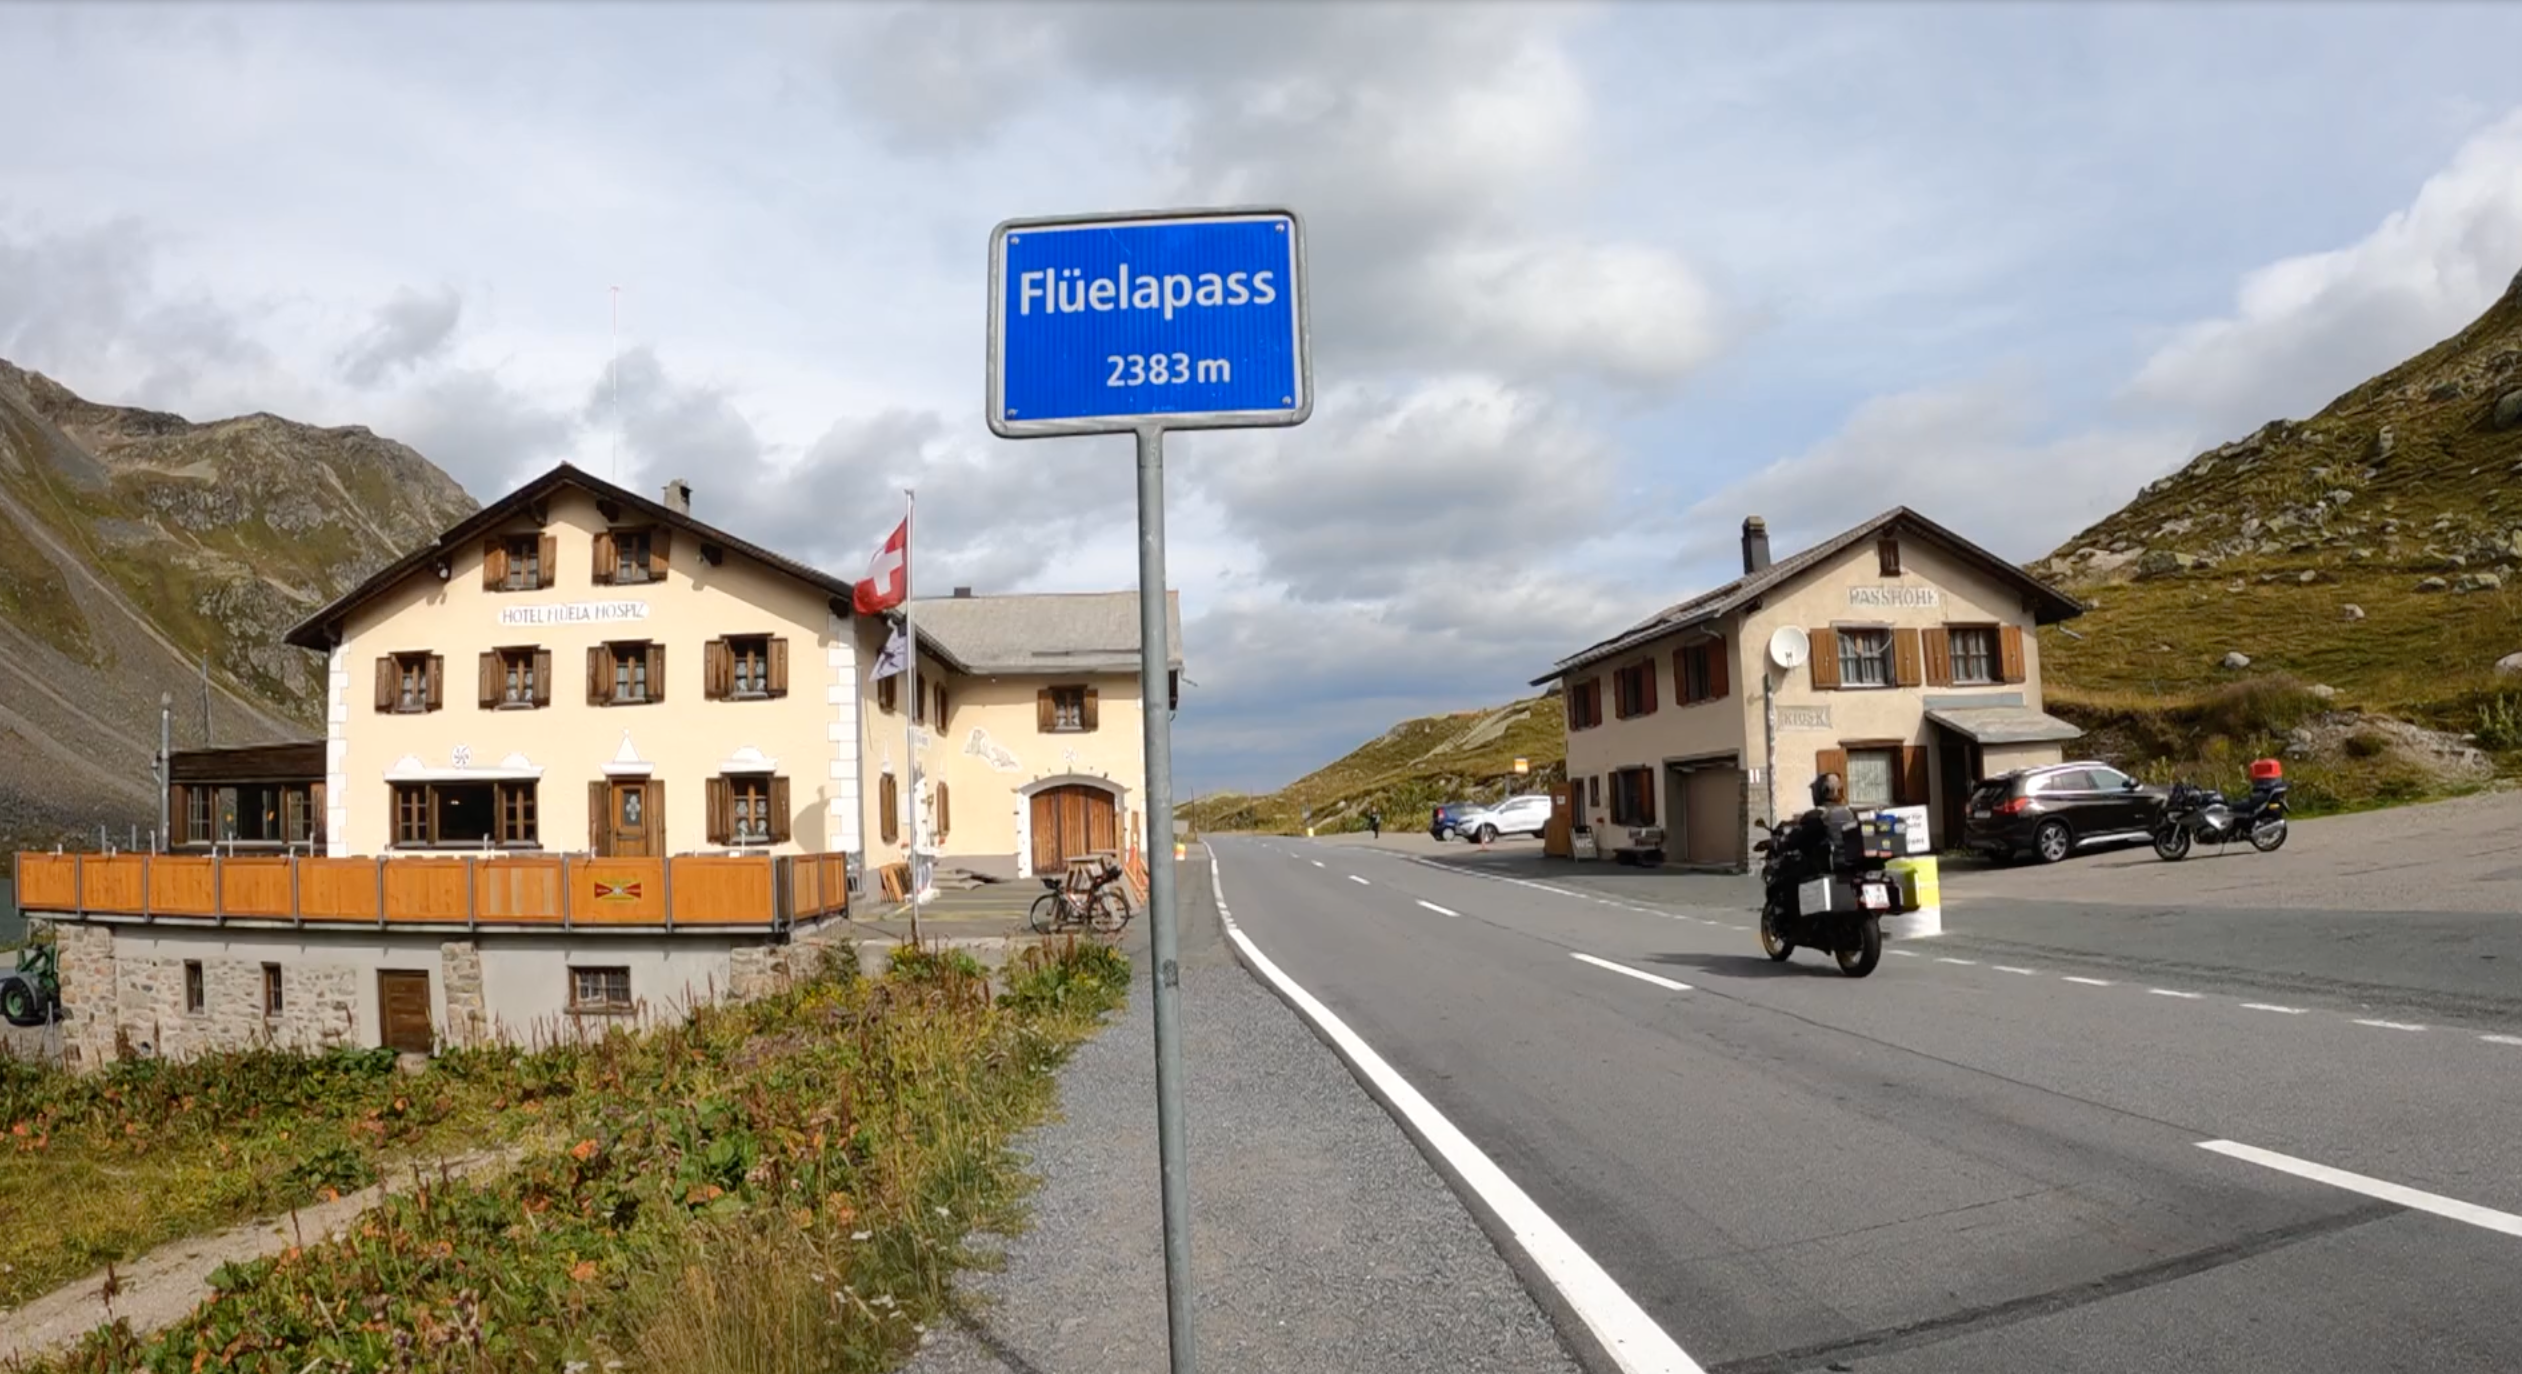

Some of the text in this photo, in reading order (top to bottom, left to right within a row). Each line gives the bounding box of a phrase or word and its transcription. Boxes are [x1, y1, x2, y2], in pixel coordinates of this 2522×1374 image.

[1020, 263, 1276, 320] Flüelapass
[1106, 353, 1231, 387] 2383 m
[502, 608, 544, 624] HOTEL
[595, 602, 645, 620] HOSPIZ
